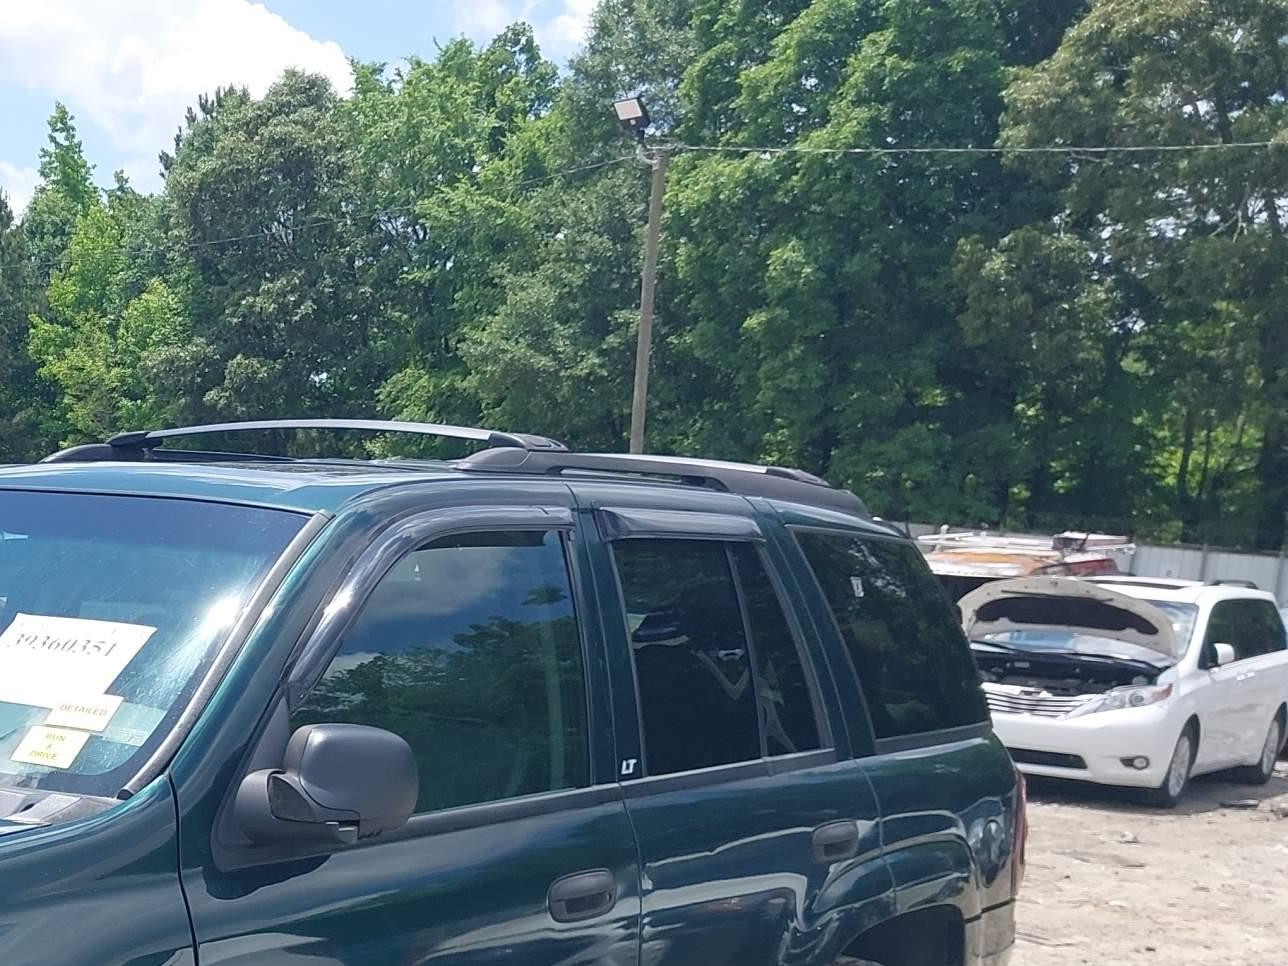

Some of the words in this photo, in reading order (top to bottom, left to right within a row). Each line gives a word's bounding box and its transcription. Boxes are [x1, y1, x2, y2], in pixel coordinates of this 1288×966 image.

[59, 703, 108, 717] DETAILED
[28, 750, 58, 761] DRIVE
[620, 758, 638, 775] LT
